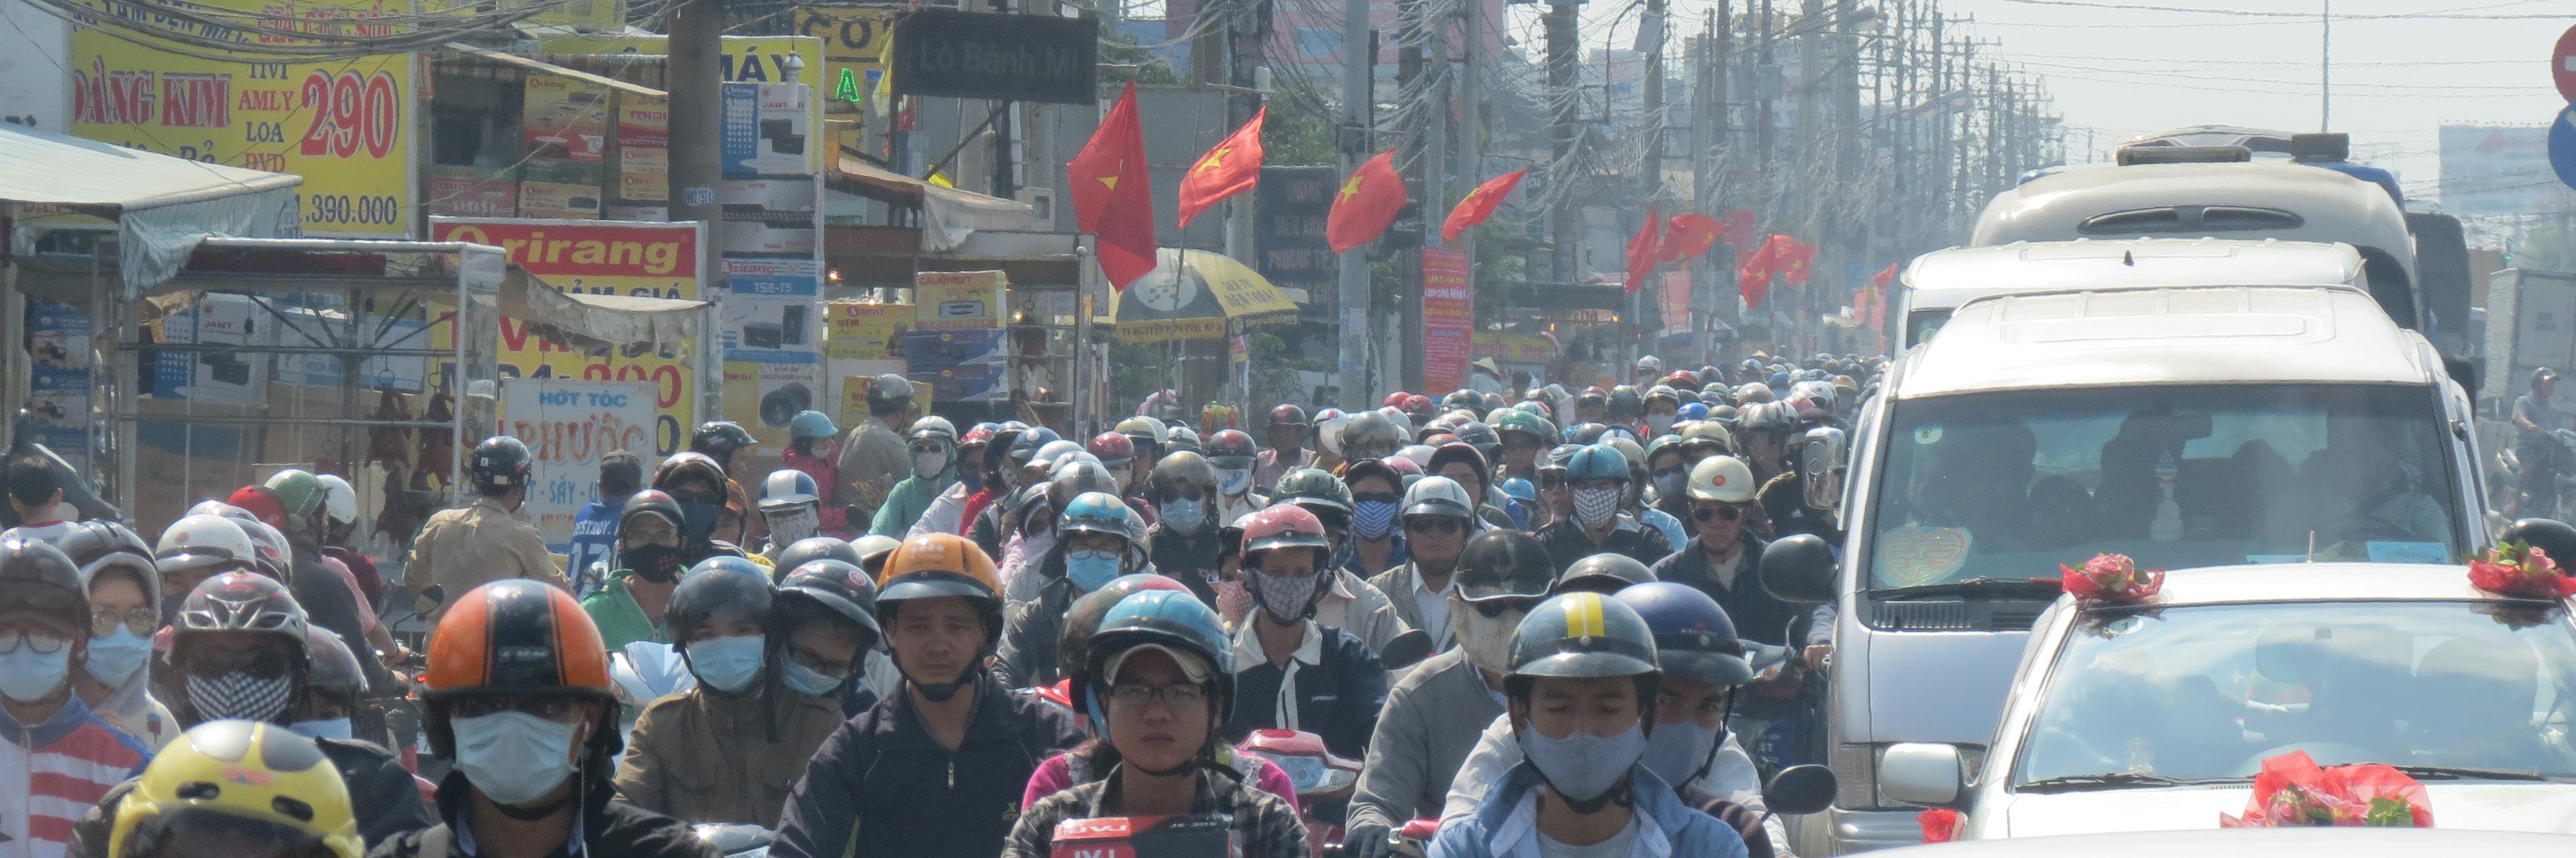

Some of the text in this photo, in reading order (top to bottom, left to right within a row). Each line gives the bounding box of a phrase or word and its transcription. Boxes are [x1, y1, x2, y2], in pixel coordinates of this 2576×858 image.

[160, 72, 232, 127] KIM
[238, 89, 294, 111] AMLY
[300, 69, 400, 159] 290
[245, 121, 285, 143] LOA
[245, 153, 286, 173] DVD
[587, 390, 627, 408] TÓC
